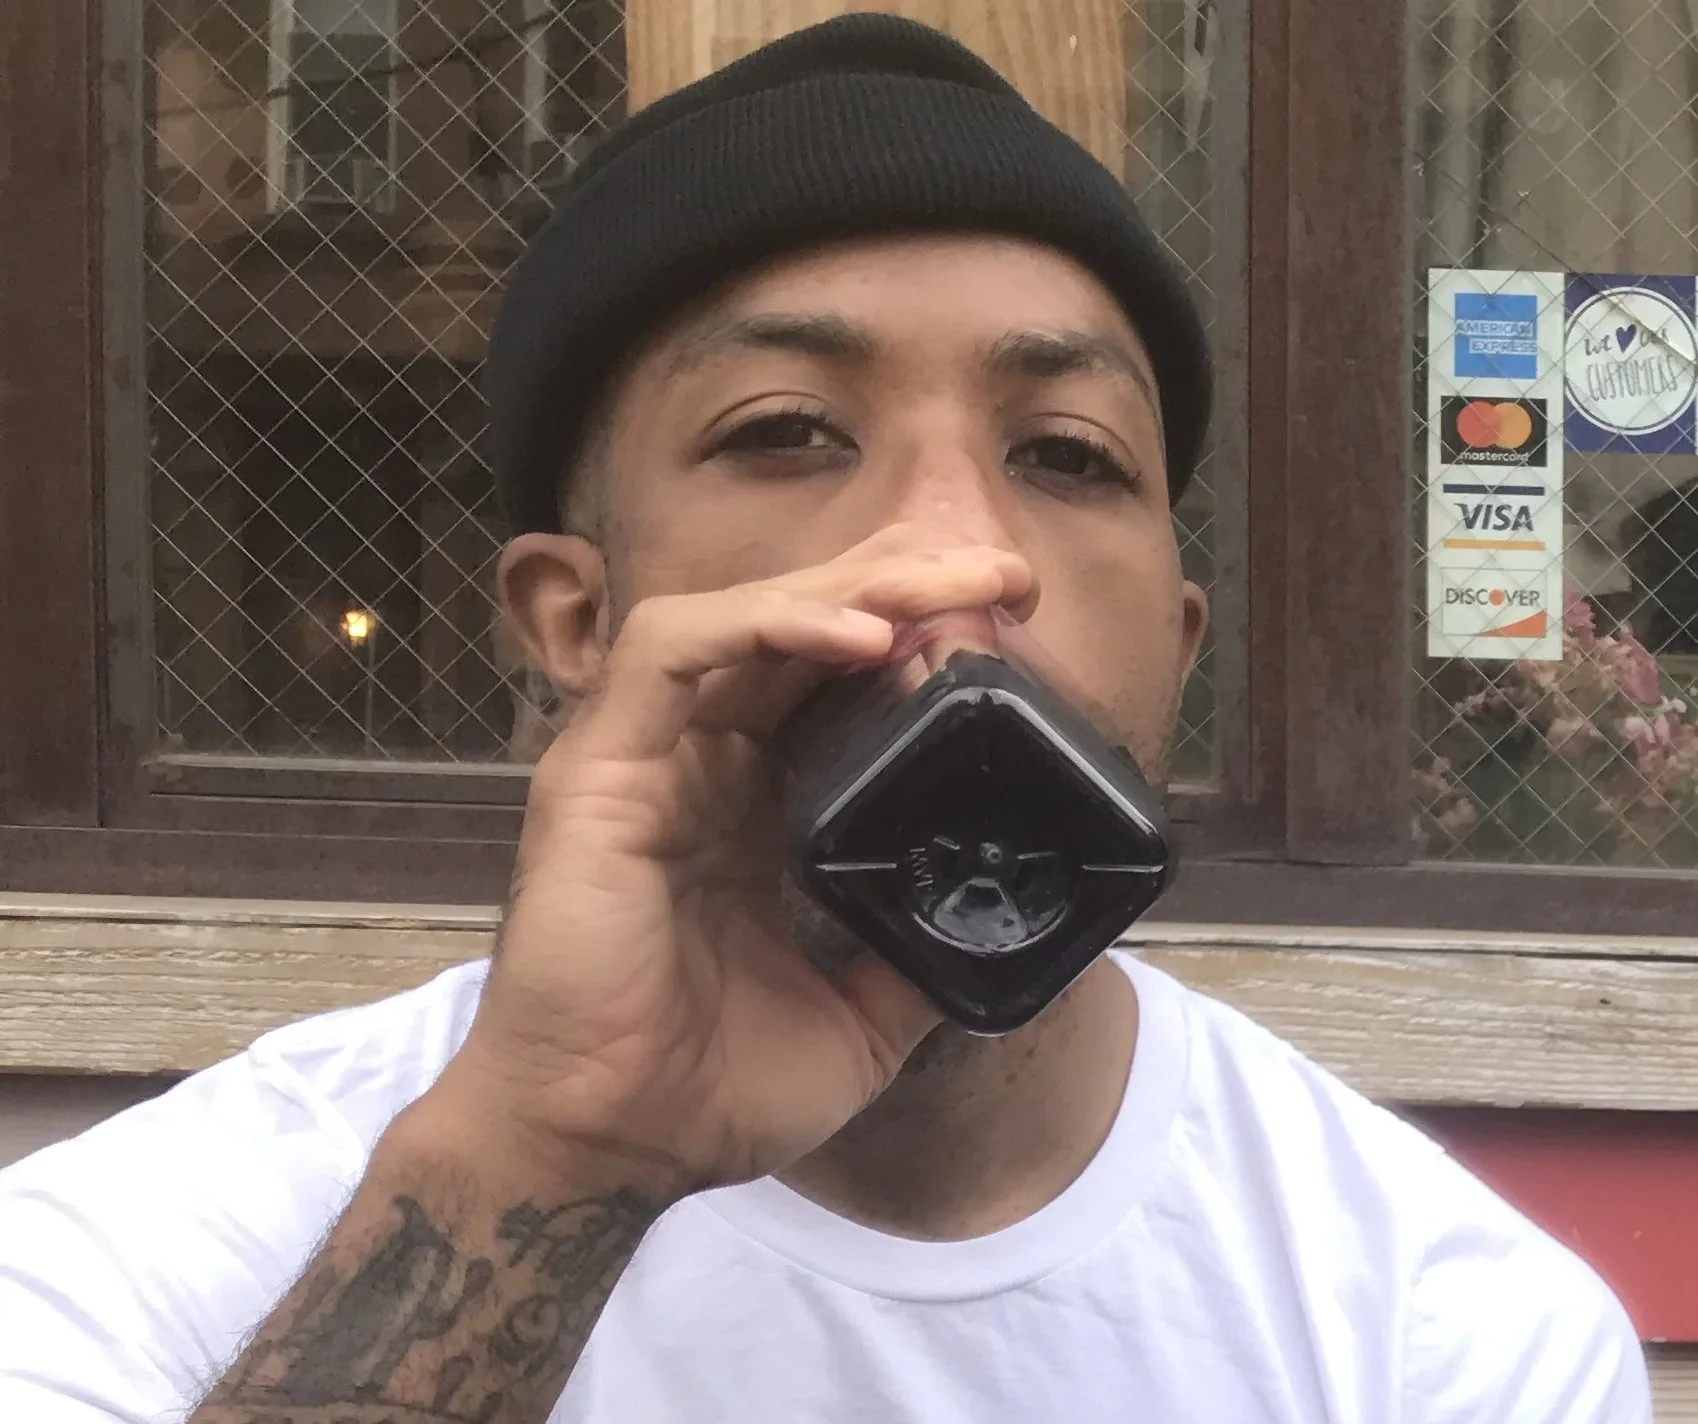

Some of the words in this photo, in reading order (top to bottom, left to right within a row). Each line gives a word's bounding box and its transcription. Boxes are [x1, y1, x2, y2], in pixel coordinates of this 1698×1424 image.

[1455, 319, 1534, 337] AMERICAN
[1471, 339, 1538, 355] EXPRESS
[1586, 353, 1678, 402] CUSTOMERS
[1459, 451, 1530, 463] mastercard
[1453, 502, 1535, 532] VISA
[1444, 587, 1541, 607] DISCOVER
